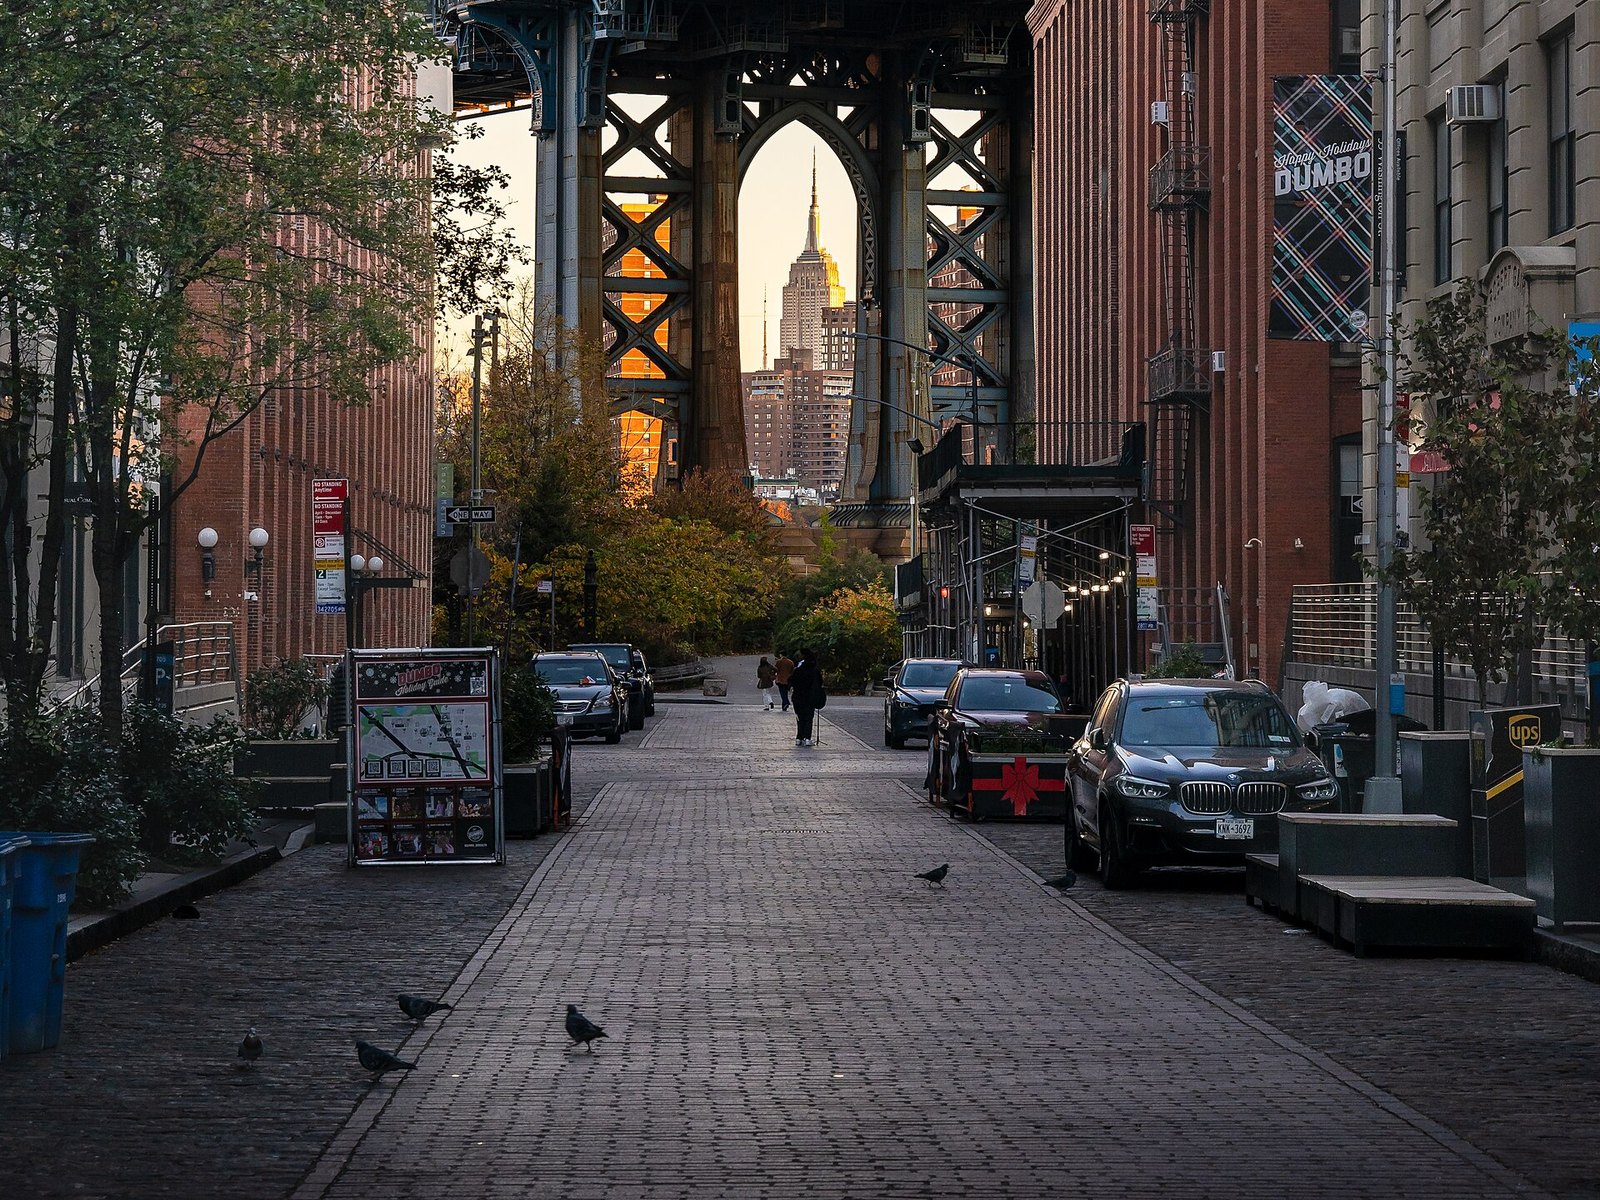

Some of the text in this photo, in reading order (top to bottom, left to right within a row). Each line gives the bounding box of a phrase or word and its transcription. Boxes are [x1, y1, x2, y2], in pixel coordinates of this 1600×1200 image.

[1274, 138, 1372, 168] Happy Holidays
[1274, 151, 1371, 197] DUMBO
[318, 569, 324, 579] 2
[990, 653, 996, 662] P
[155, 667, 166, 685] P
[395, 674, 450, 697] Holiday Guide
[397, 663, 442, 686] DUMBO
[1511, 725, 1539, 746] ups
